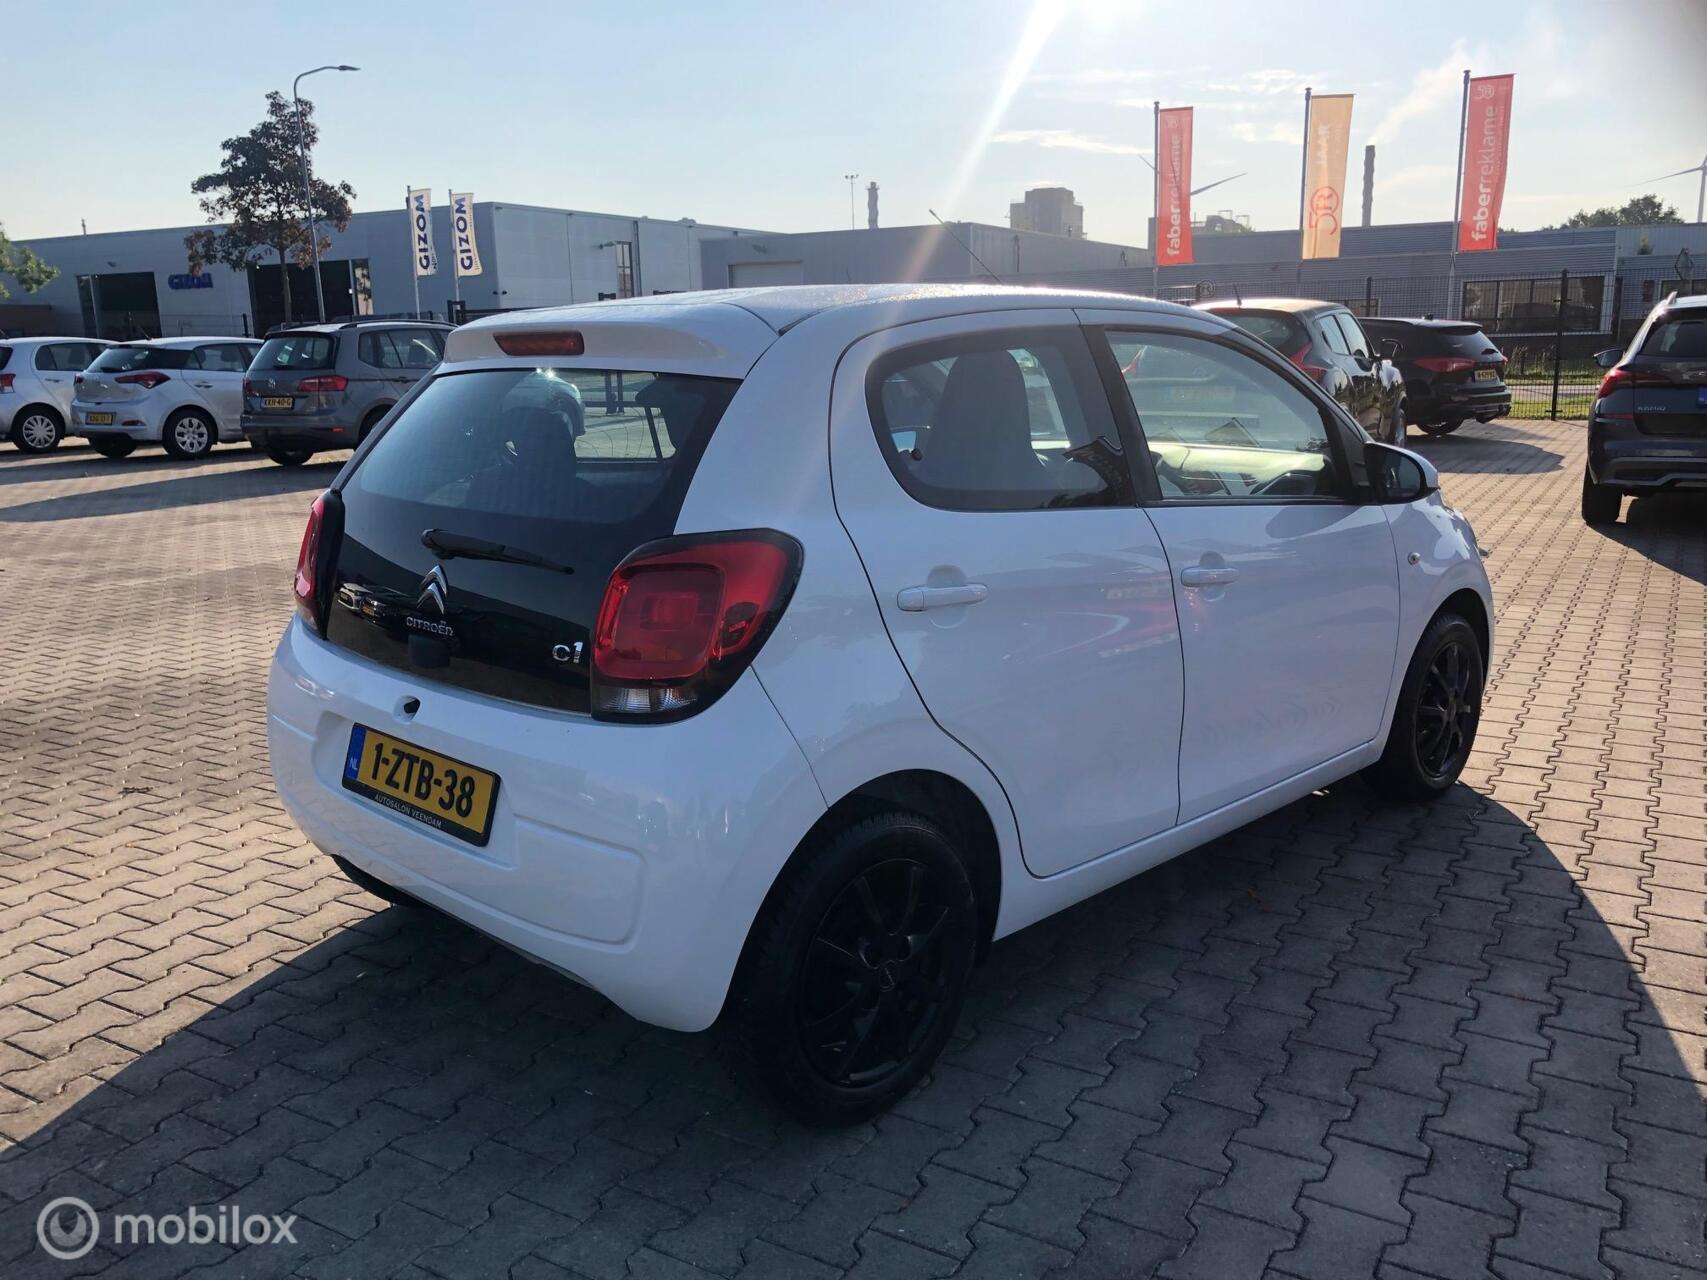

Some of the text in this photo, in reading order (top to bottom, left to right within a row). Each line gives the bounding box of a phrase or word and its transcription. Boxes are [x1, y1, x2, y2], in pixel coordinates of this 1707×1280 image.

[1471, 105, 1497, 241] faberreklame
[414, 193, 431, 270] GIZOM
[455, 197, 474, 271] GIZOM
[406, 616, 454, 637] CITROËN
[552, 641, 584, 664] C1
[349, 757, 358, 771] NL
[371, 742, 476, 818] 1-ZTB-38
[374, 793, 442, 829] AUTOSALON VEENDAM
